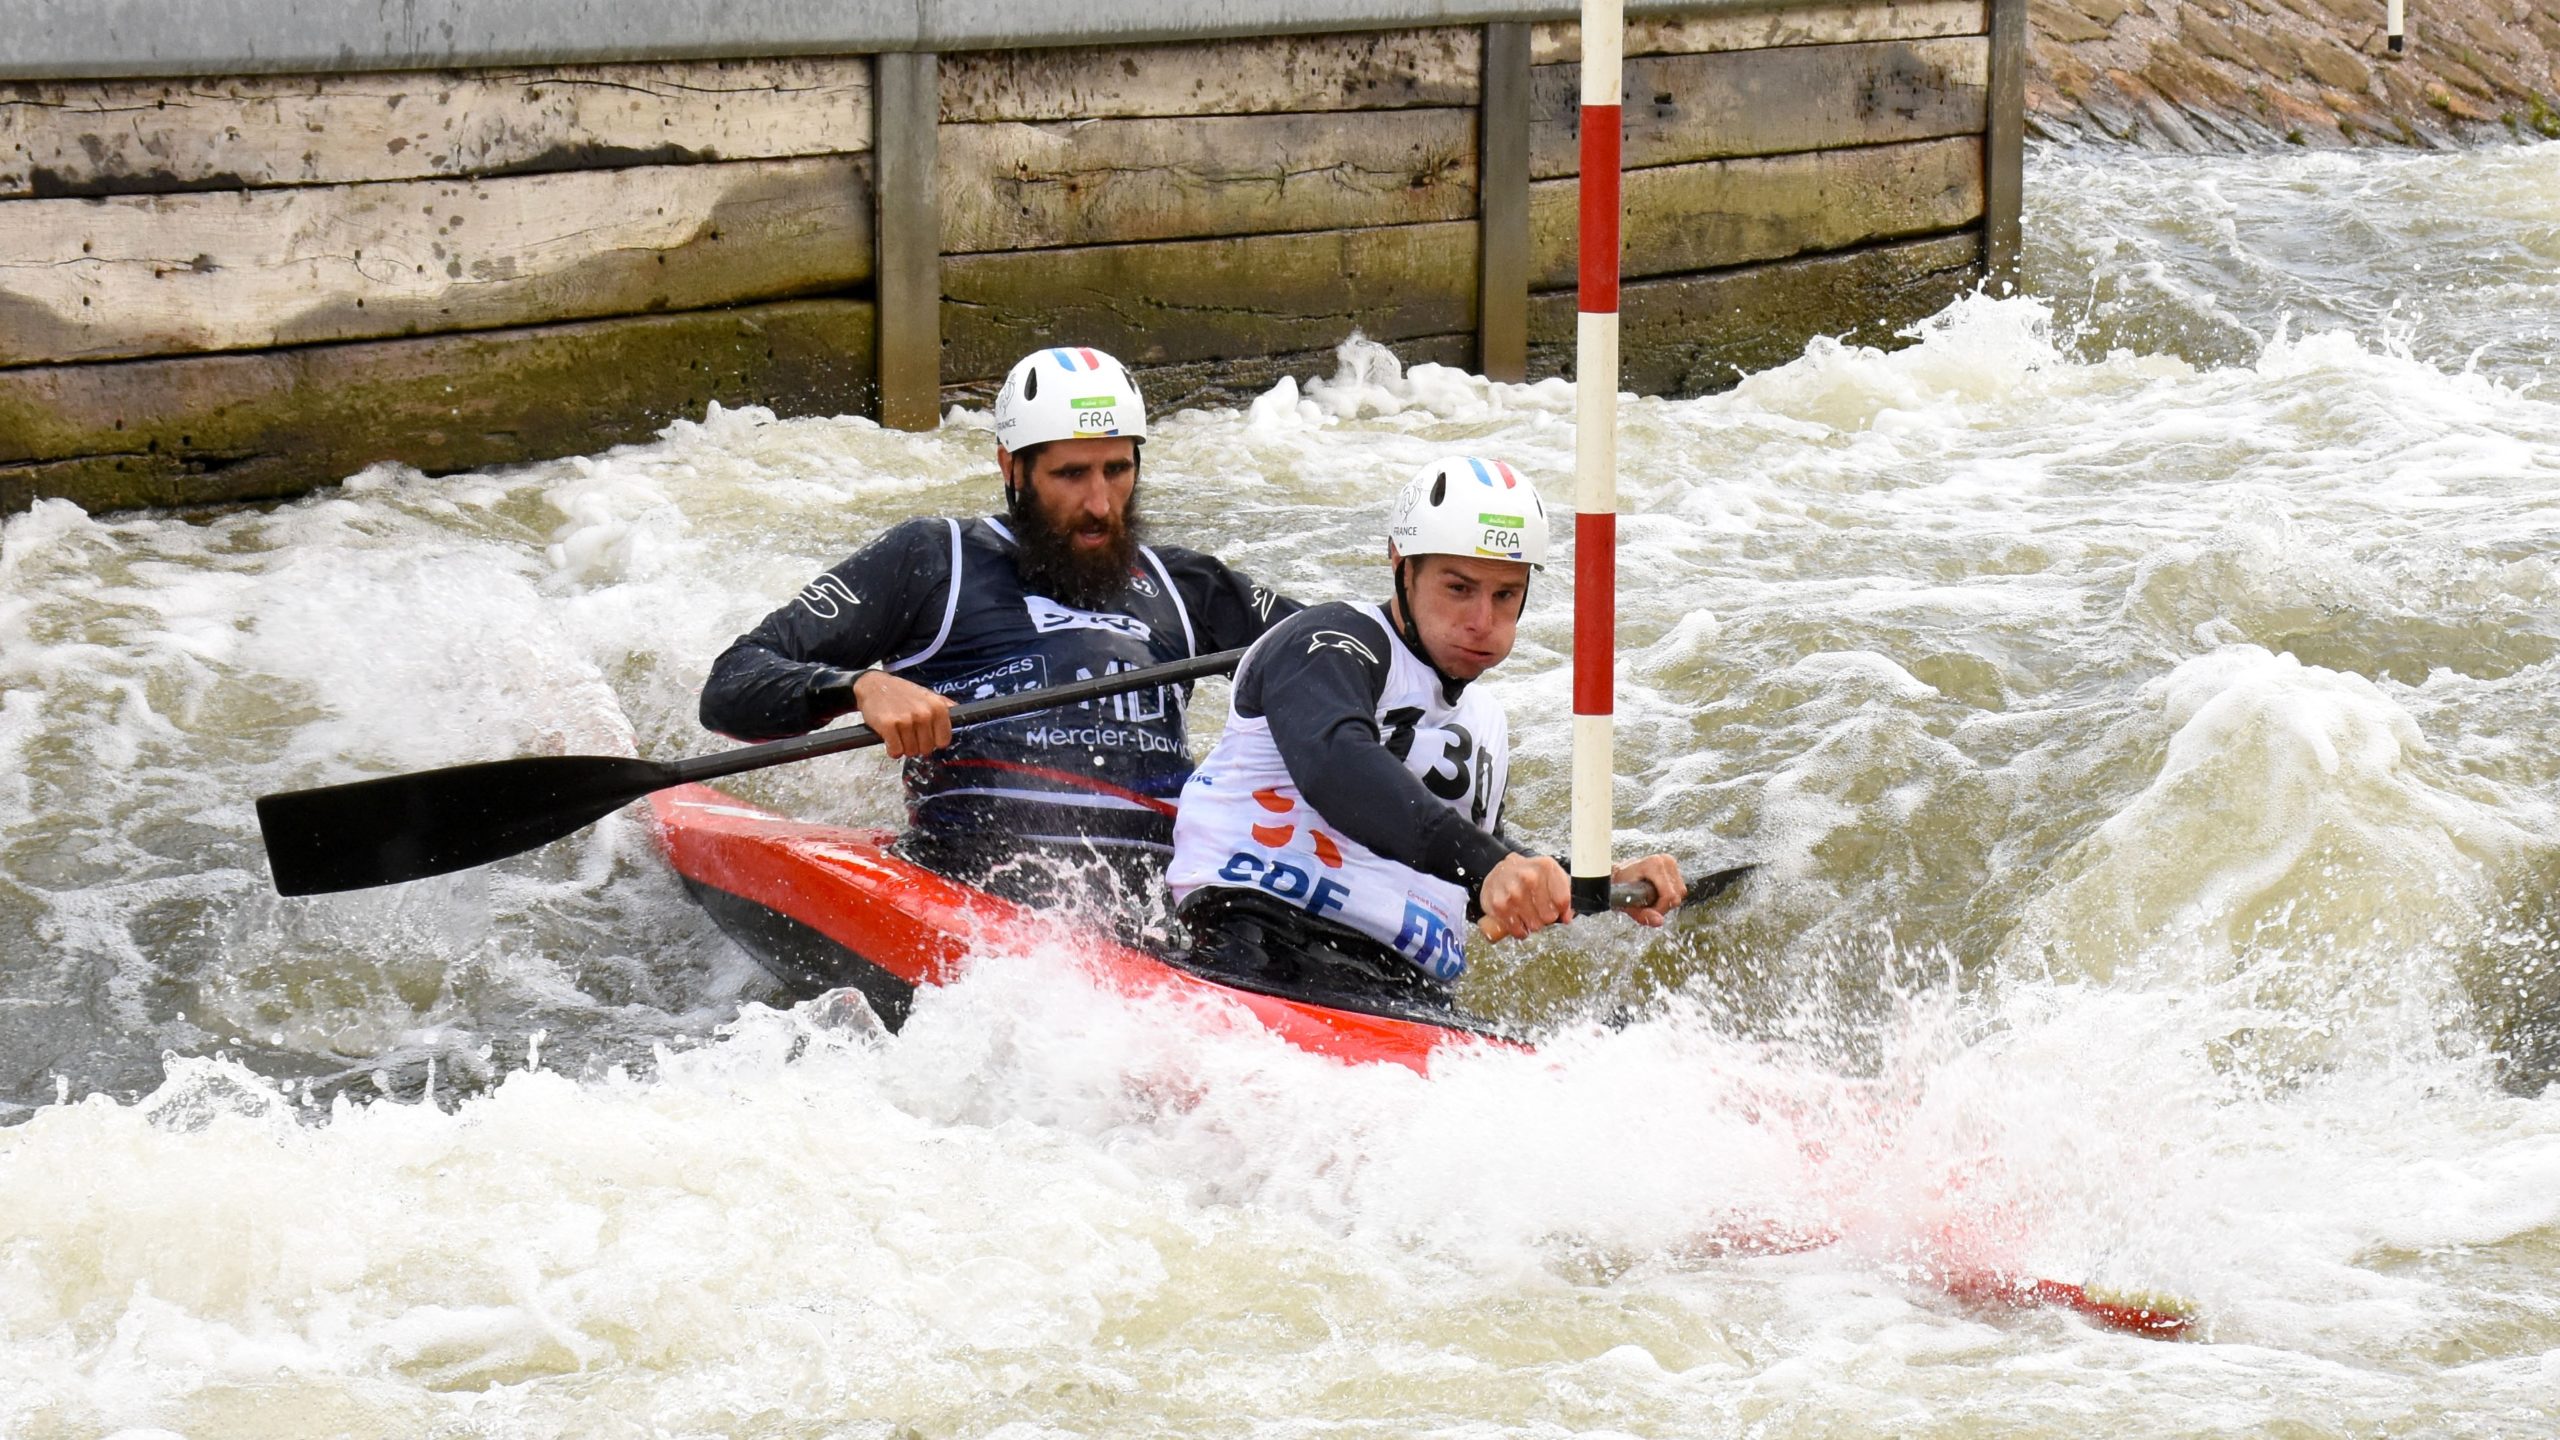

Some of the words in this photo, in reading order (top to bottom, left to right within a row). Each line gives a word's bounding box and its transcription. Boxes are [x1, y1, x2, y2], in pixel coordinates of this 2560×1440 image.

[1079, 411, 1115, 428] FRA
[1483, 529, 1520, 549] FRA
[933, 658, 1034, 695] VACANCES
